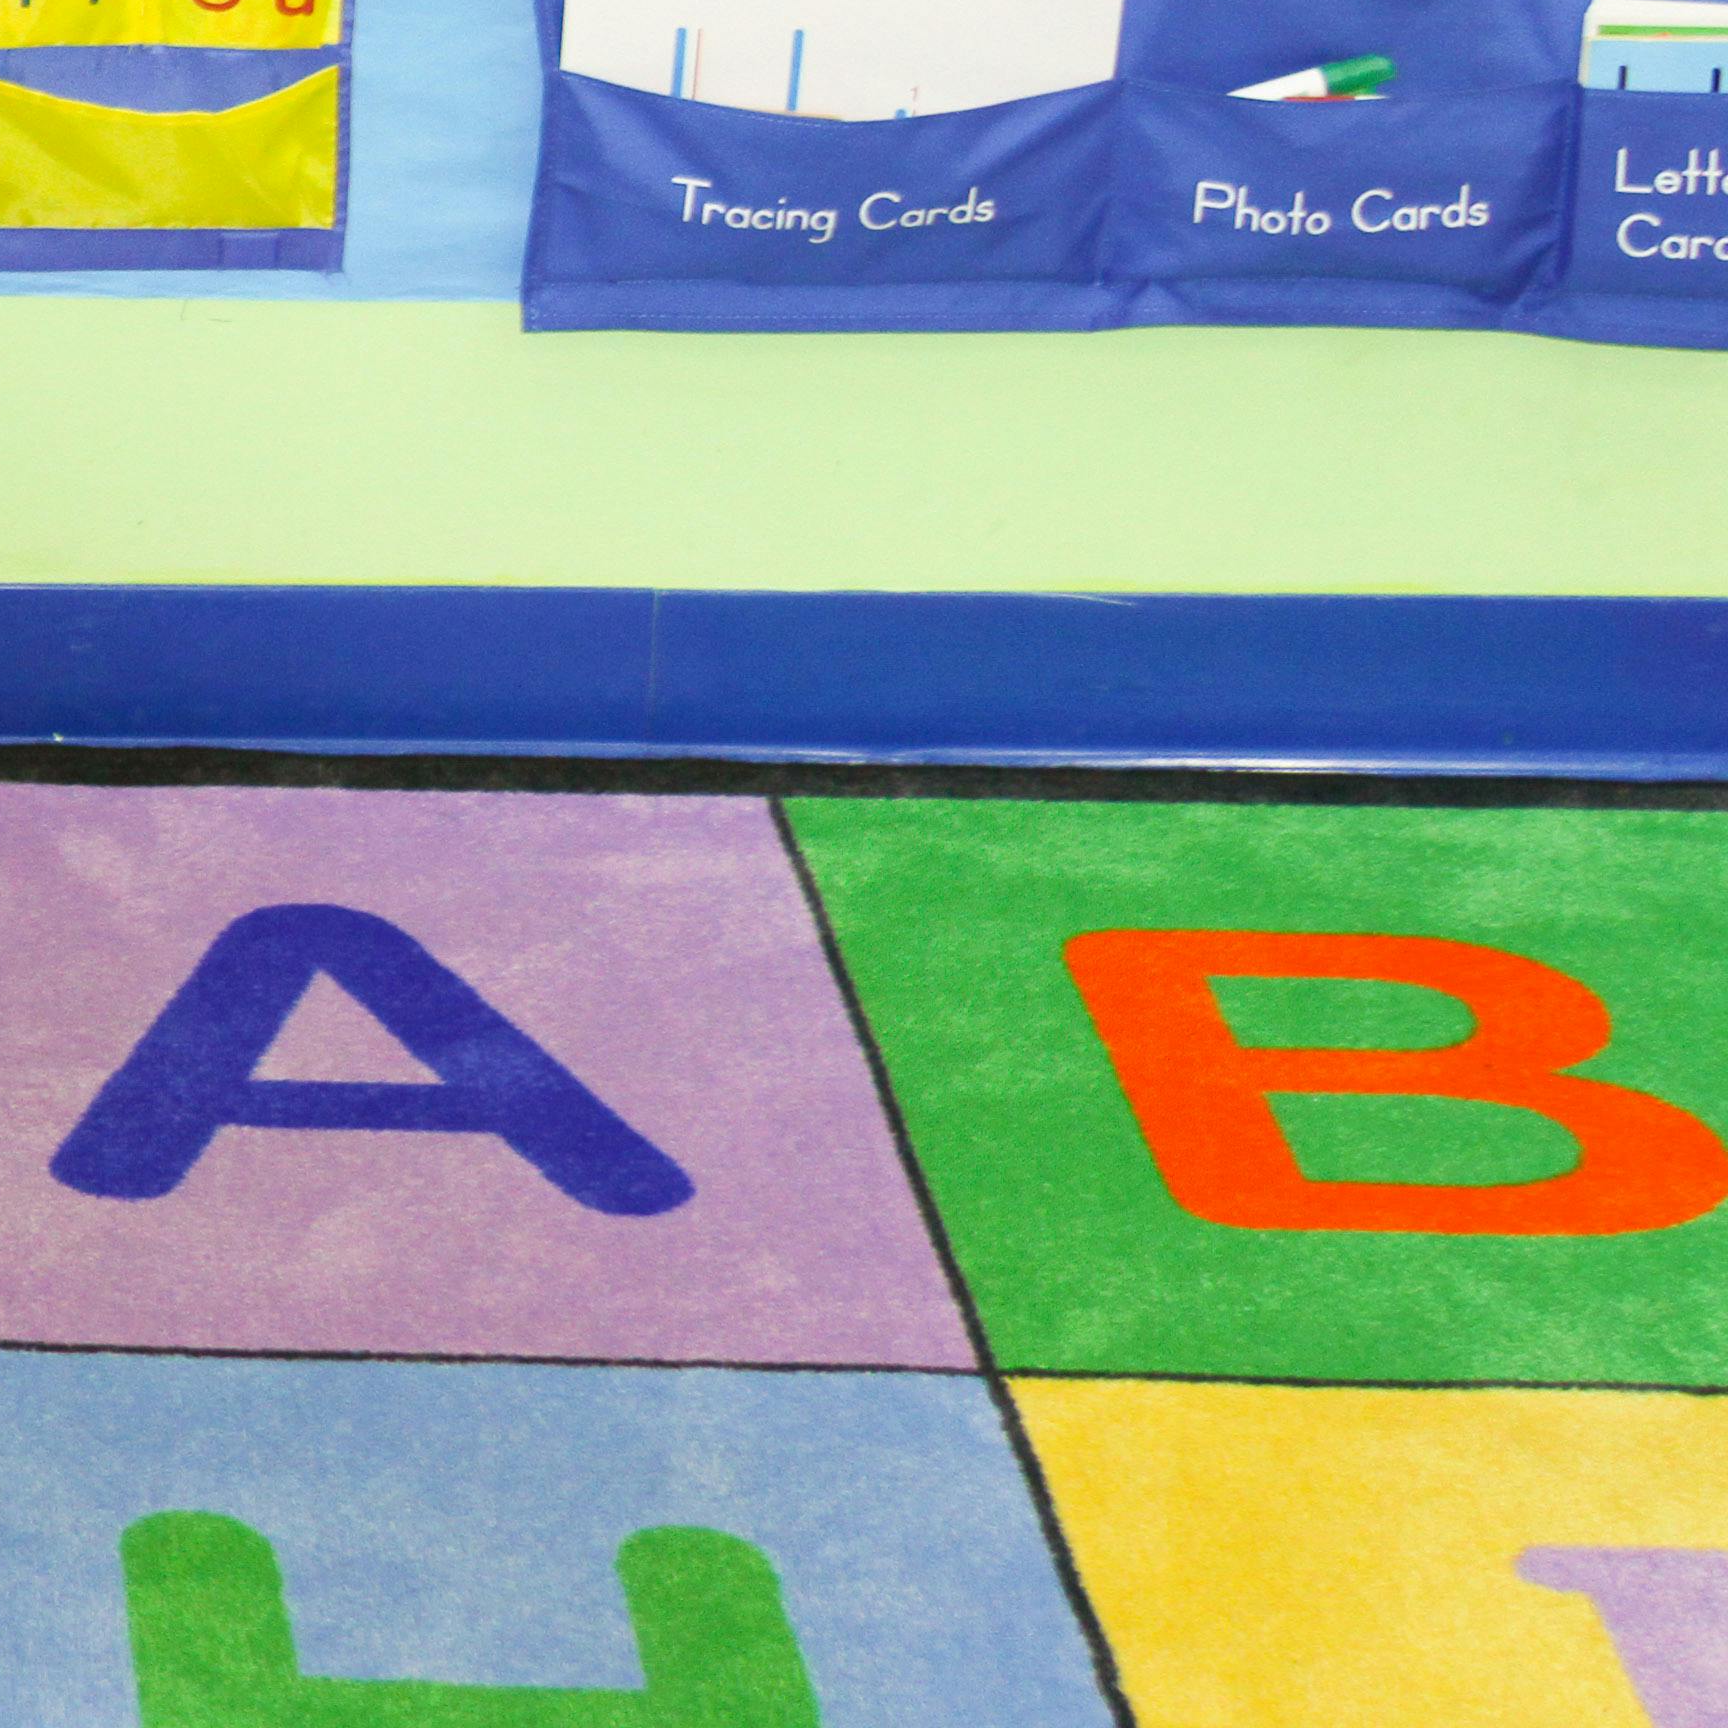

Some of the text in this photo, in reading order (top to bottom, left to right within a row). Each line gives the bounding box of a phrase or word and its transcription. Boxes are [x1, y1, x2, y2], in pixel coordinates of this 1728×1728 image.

[1615, 147, 1728, 195] Lett
[671, 176, 996, 243] Tracing Cards
[1194, 181, 1490, 236] Photo Cards
[49, 902, 1728, 1239] A B
